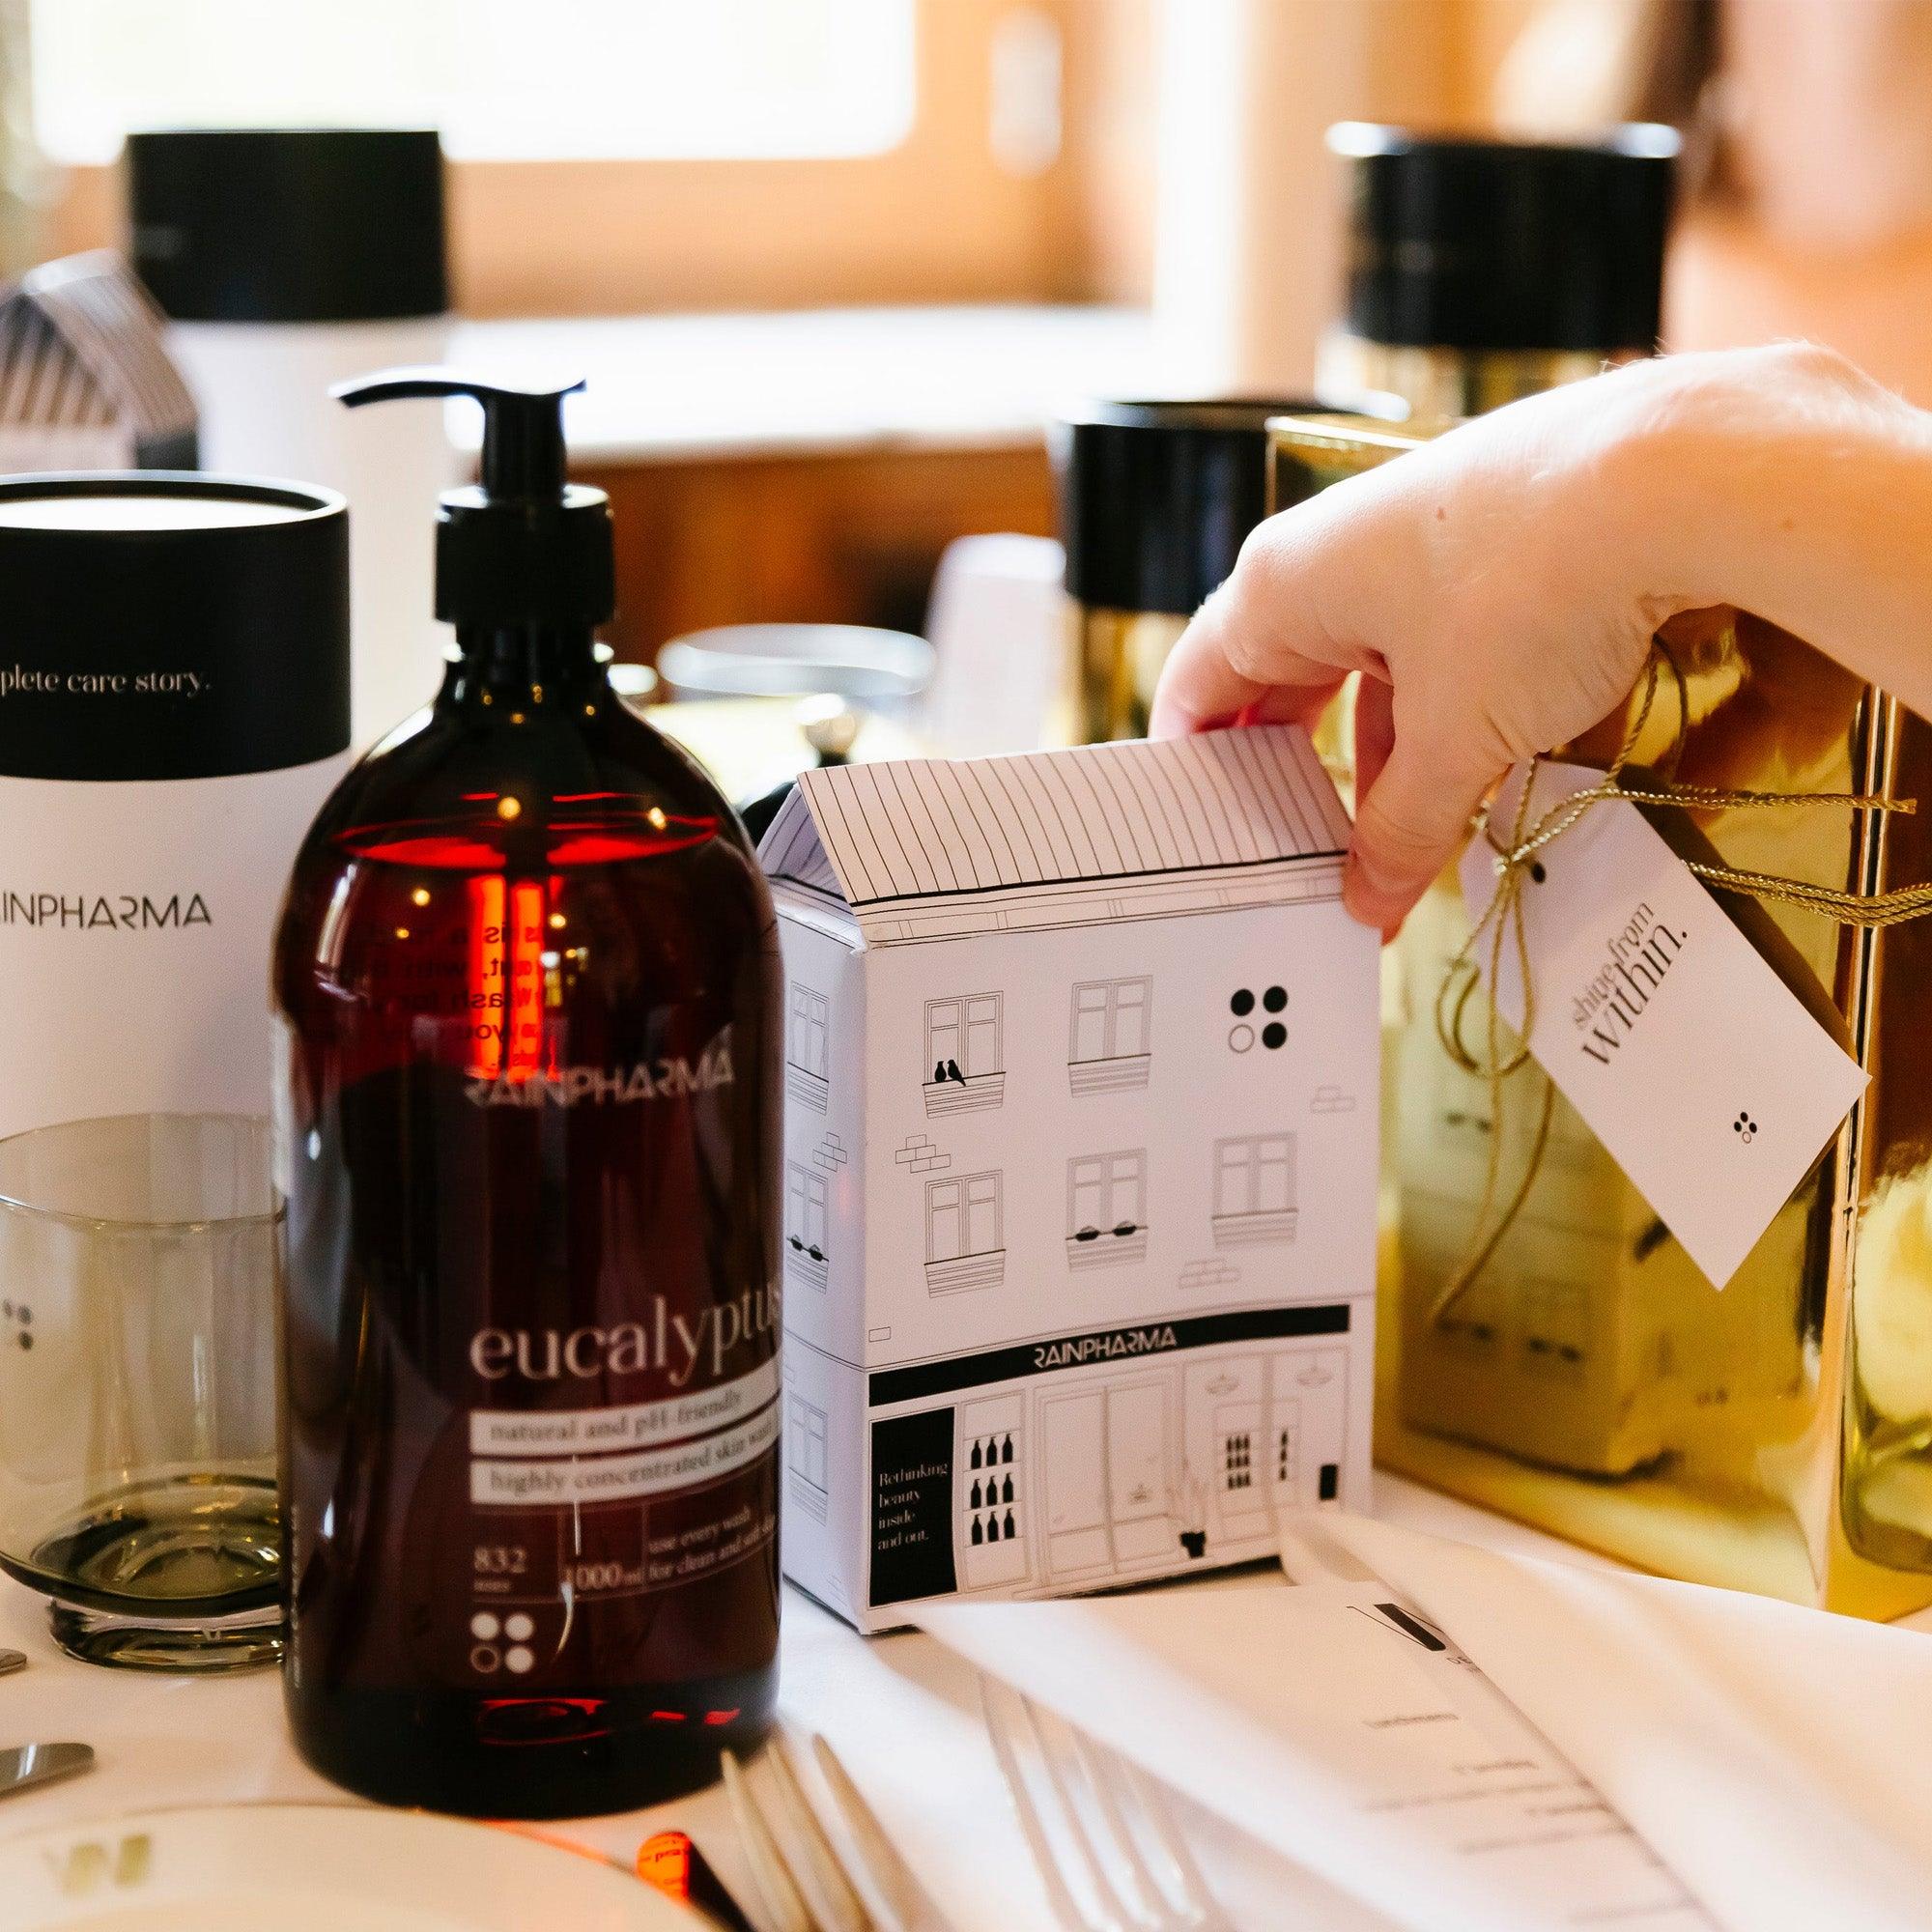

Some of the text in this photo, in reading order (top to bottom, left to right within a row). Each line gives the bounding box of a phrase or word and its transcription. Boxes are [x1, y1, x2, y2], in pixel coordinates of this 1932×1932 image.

[0, 663, 212, 697] plete care story.
[3, 890, 213, 930] INPHARMA
[1572, 902, 1655, 1031] shine from
[1581, 923, 1689, 1065] within.
[1034, 1326, 1177, 1368] RAINPHARMA
[584, 1414, 629, 1439] and
[879, 1463, 947, 1488] Rethinking
